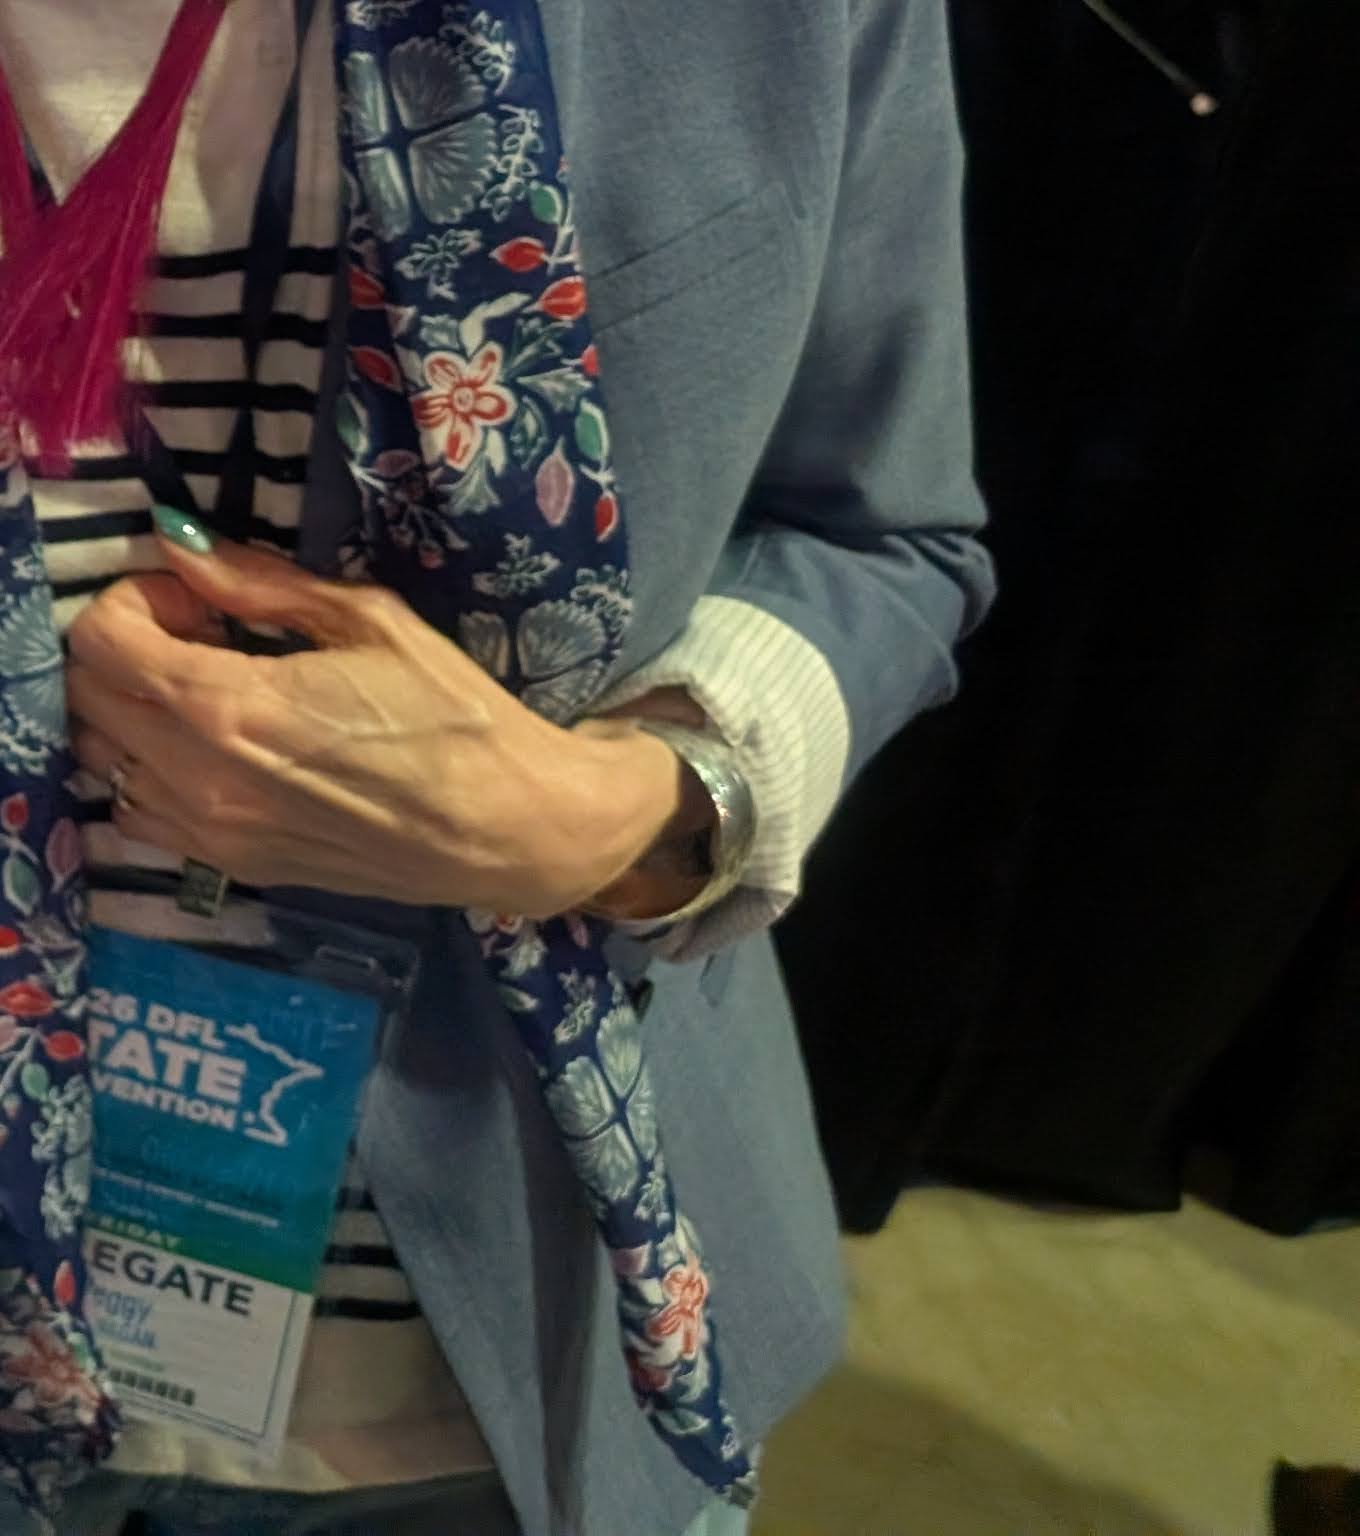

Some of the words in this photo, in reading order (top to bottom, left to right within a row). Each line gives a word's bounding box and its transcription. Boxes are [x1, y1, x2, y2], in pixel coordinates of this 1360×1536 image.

[87, 986, 139, 1024] 26
[146, 1001, 227, 1052] DFL
[86, 1017, 249, 1106] TATE
[90, 1068, 237, 1133] VENTION
[92, 1236, 257, 1319] EGATE
